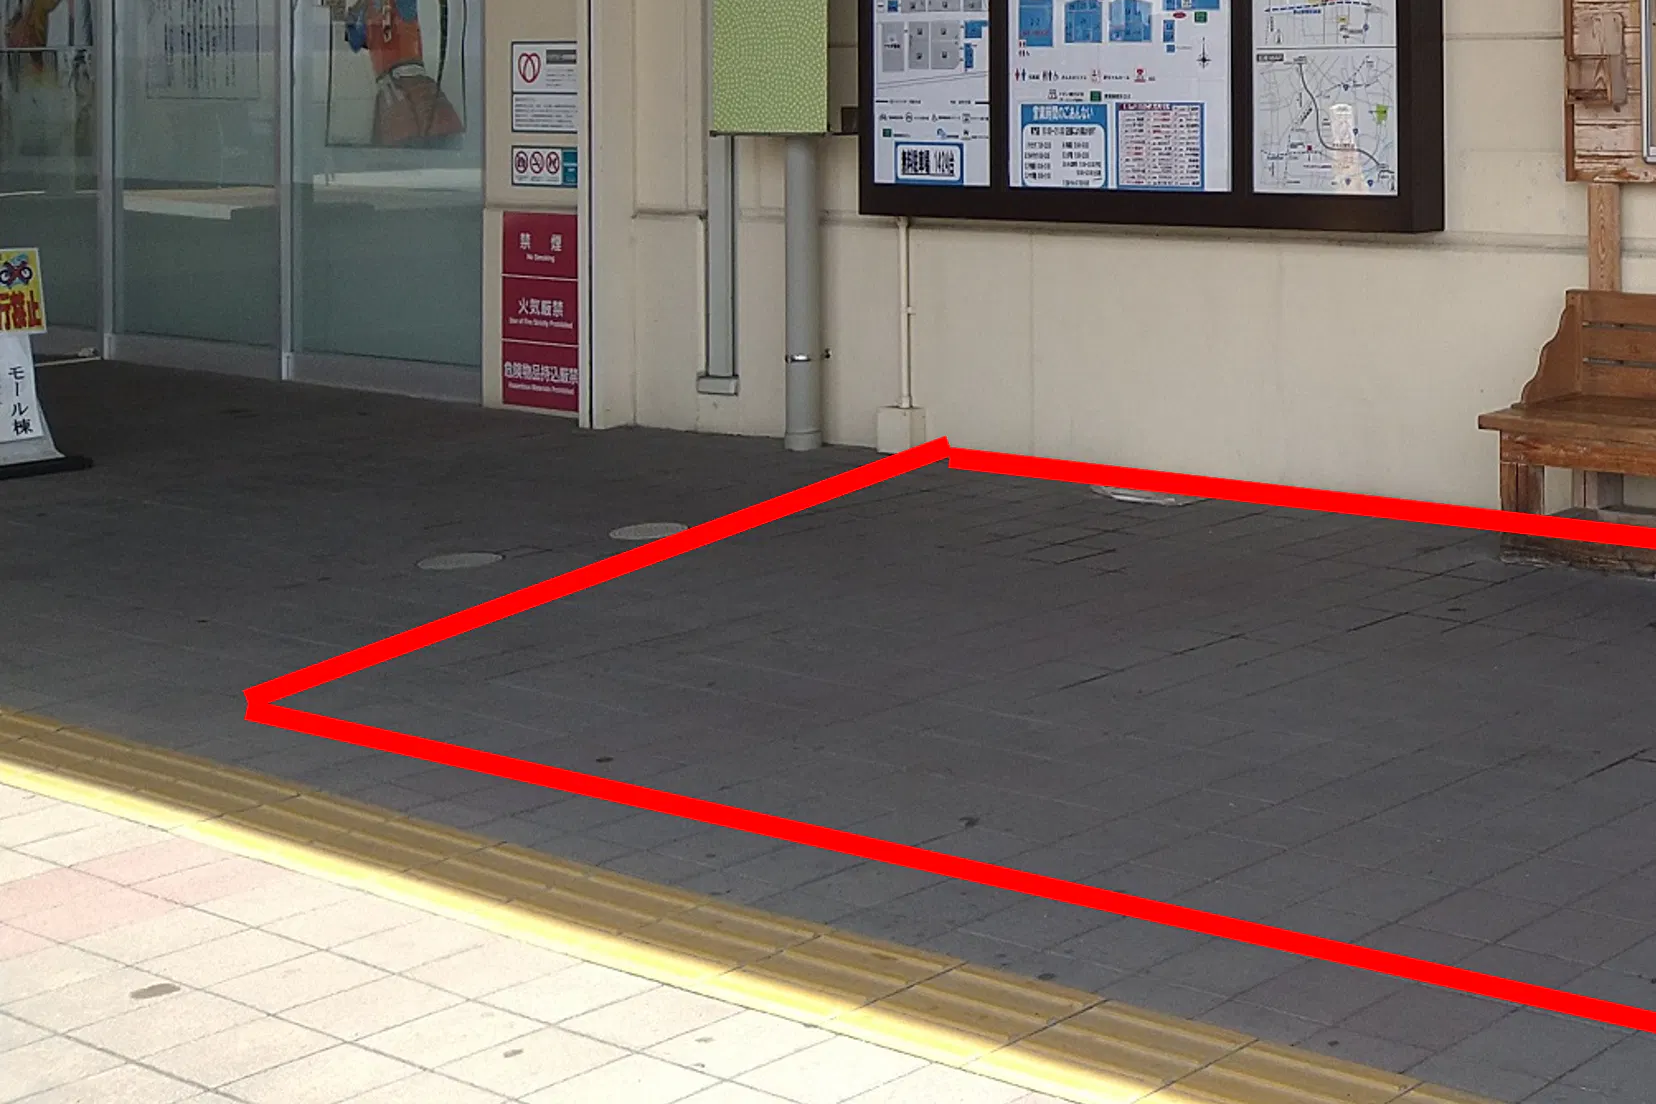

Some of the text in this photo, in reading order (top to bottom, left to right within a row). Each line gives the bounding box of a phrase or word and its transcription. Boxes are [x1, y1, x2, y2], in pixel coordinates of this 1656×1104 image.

[520, 232, 563, 252] 禁煙
[518, 297, 564, 317] 火気厳禁
[8, 365, 35, 436] モール棟
